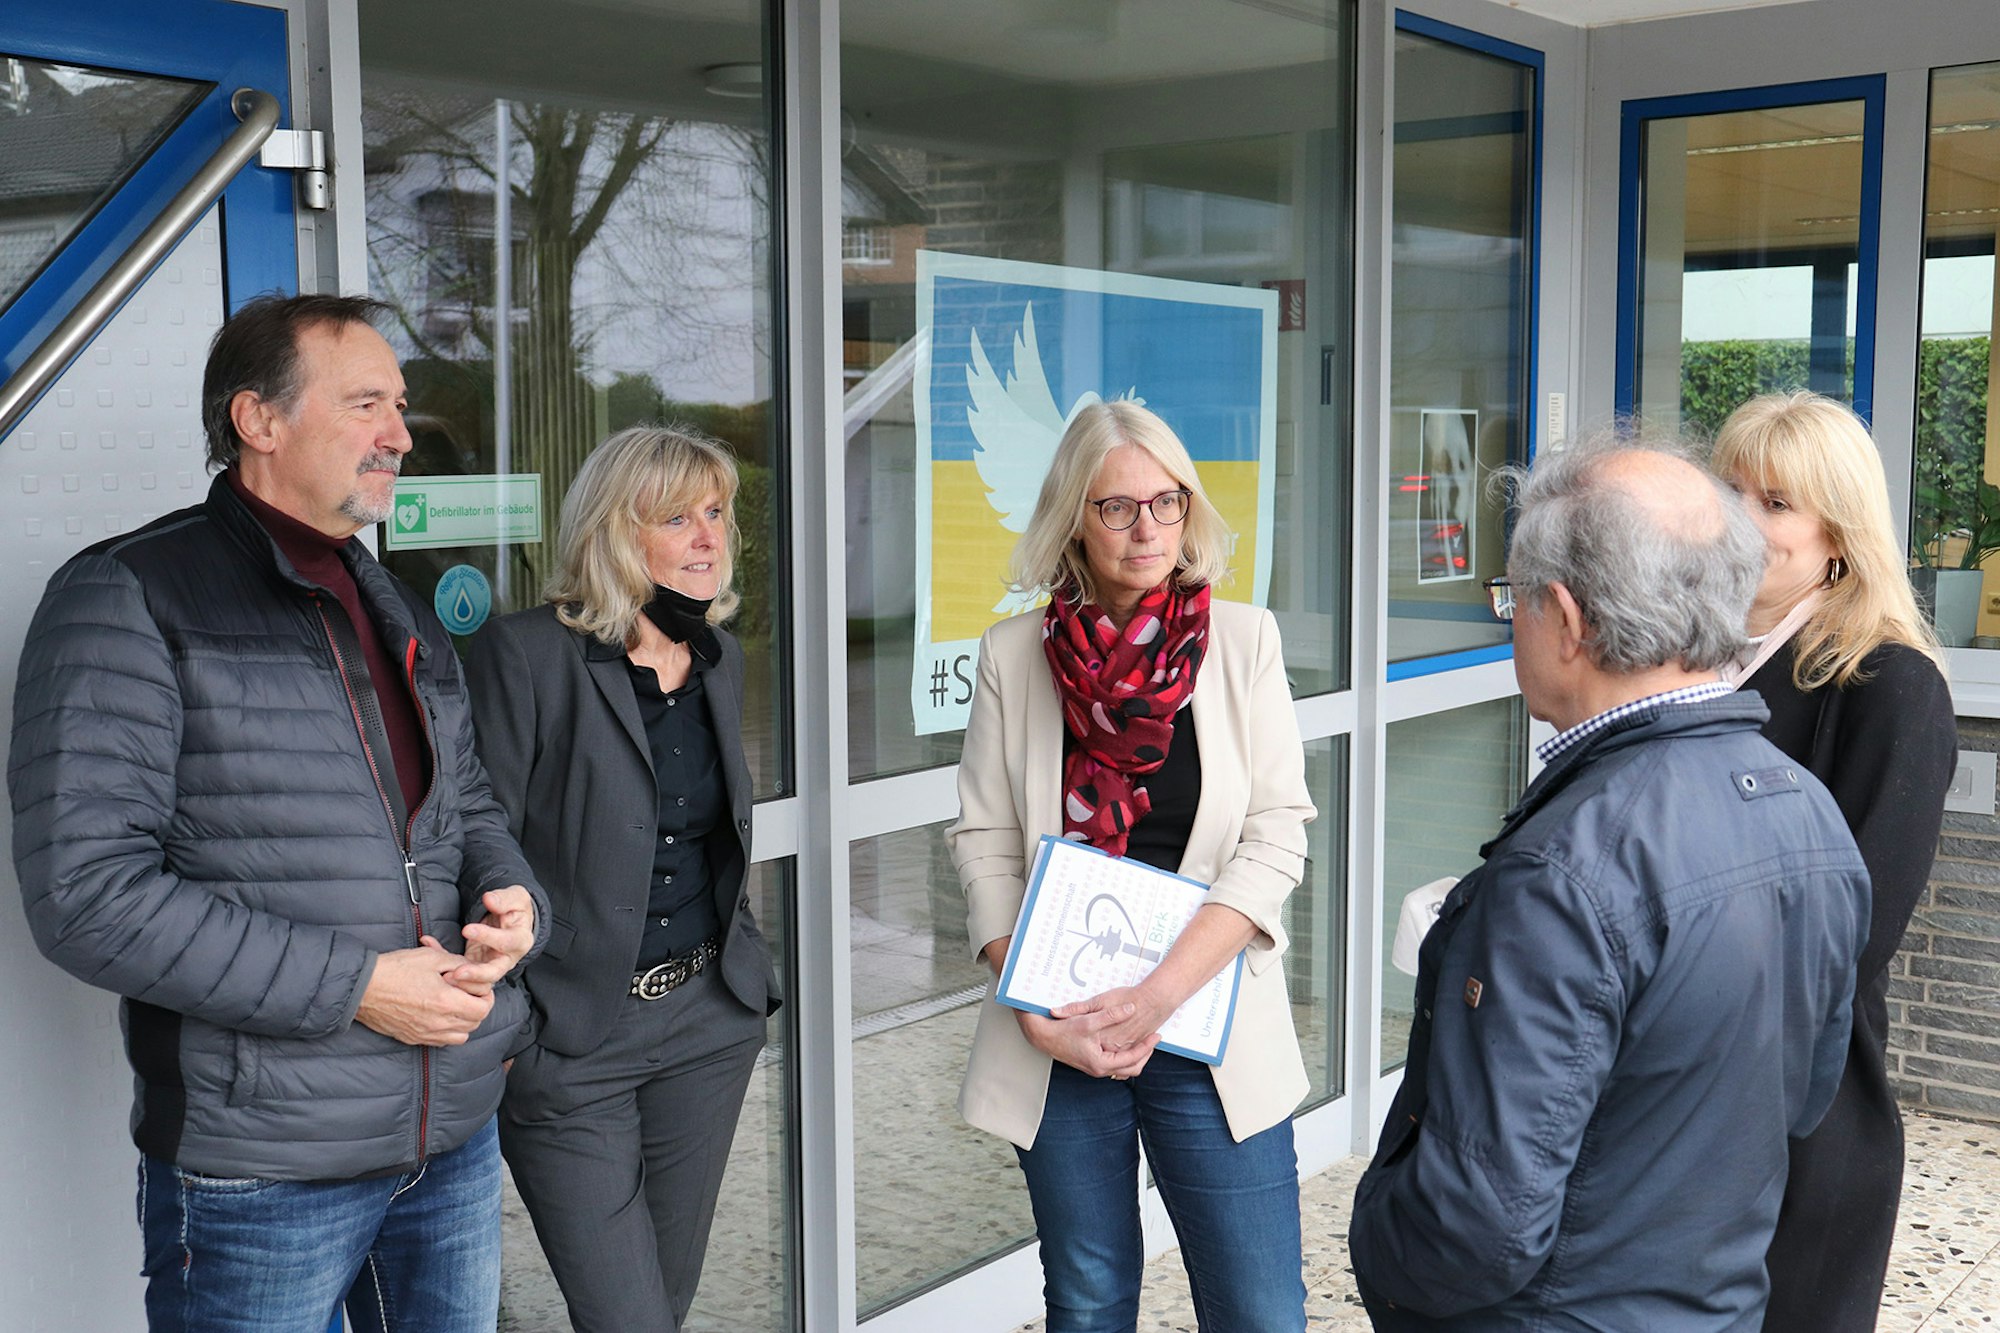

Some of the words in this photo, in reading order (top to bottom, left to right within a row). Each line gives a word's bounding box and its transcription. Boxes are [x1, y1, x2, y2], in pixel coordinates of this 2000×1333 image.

[429, 506, 481, 518] Defibrillator
[483, 505, 495, 515] im
[497, 503, 534, 514] Gebäude
[459, 567, 486, 591] Station
[1041, 882, 1078, 977] Interessengemeinschaft
[1148, 911, 1169, 944] Birk
